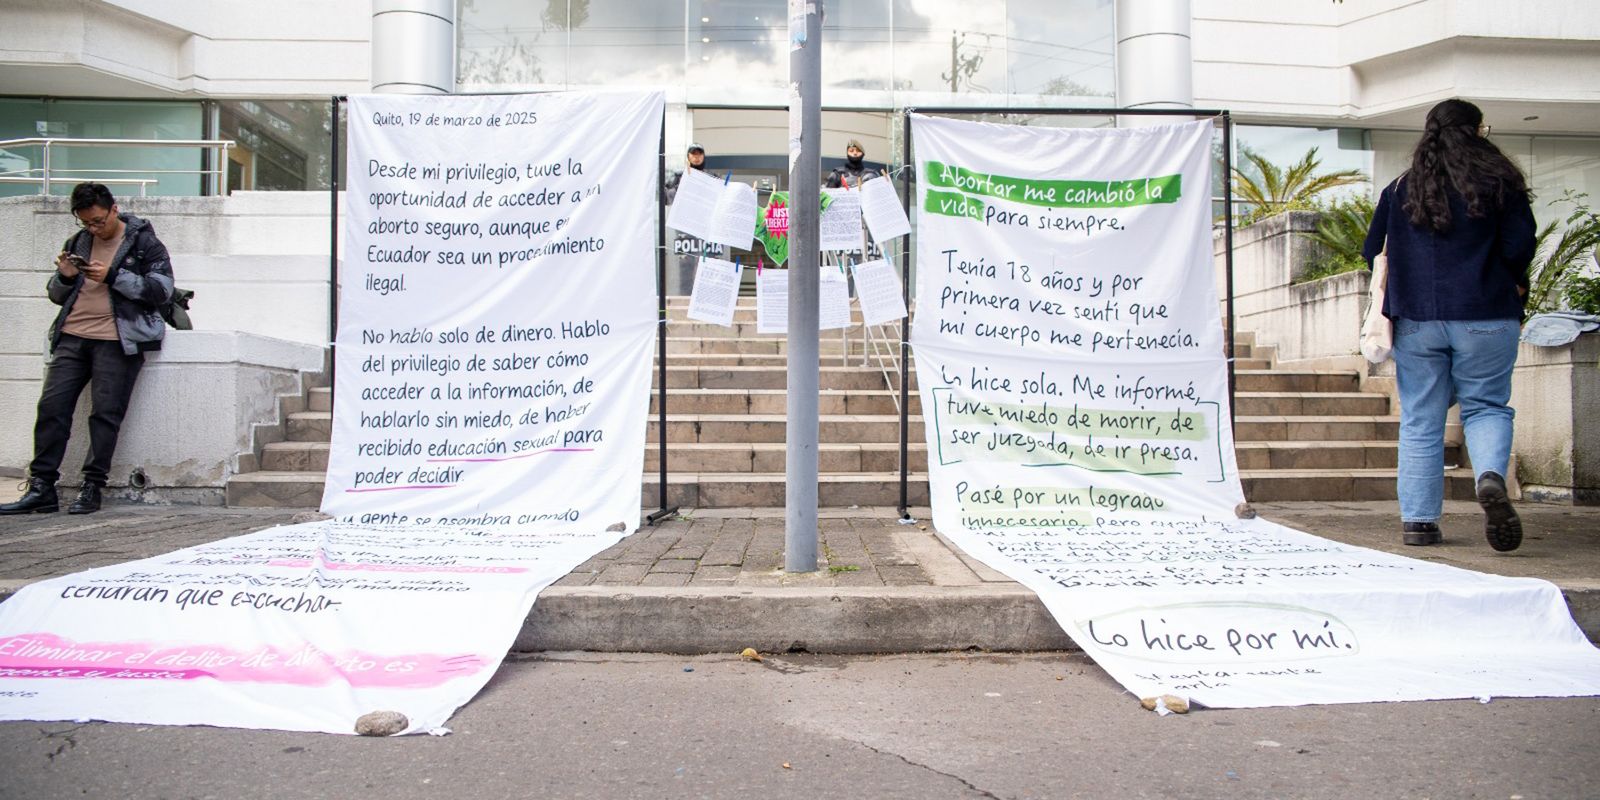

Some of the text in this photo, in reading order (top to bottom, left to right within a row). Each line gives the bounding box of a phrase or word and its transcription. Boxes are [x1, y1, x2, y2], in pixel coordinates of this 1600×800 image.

[373, 112, 537, 127] Quito, 19 de marzo de 2025
[369, 158, 583, 184] Desde mi privilegio, tuve la
[940, 165, 1162, 203] Abortar me cambió la
[369, 190, 467, 210] oportunidad
[473, 190, 492, 208] de
[499, 187, 565, 207] acceder
[571, 191, 581, 203] a
[368, 217, 418, 234] aborto
[425, 222, 482, 240] seguro,
[489, 222, 550, 239] aunque
[940, 197, 1124, 236] vida para siempre.
[368, 245, 431, 263] Ecuador
[437, 252, 465, 264] sea
[472, 252, 492, 264] un
[366, 273, 406, 296] ilegal.
[942, 250, 1143, 297] Tenía 18 años y por
[941, 280, 1168, 326] primera vez sentí que
[363, 320, 609, 344] No hablo solo de dinero. Hablo
[940, 311, 1199, 352] mi cuerpo me pertenecía.
[362, 350, 588, 376] del privilegio de saber cómo
[362, 376, 593, 400] acceder a la información, de
[971, 367, 1012, 392] hice
[1021, 372, 1062, 396] sola.
[1073, 374, 1105, 400] Me
[1115, 374, 1202, 406] informé,
[361, 403, 590, 428] hablarlo sin miedo, de haber
[948, 393, 1194, 435] tuve miedo de morir, de
[358, 430, 602, 456] recibido educación sexual para
[951, 421, 1198, 465] ser juzgada, de ir presa.
[354, 467, 403, 488] poder
[956, 481, 1164, 513] Pasé por un legrado
[962, 508, 1088, 530] innecesario.
[176, 588, 224, 610] que
[1089, 618, 1352, 655] Lo hice por mí.
[0, 638, 118, 664] Eliminar
[125, 650, 151, 664] el
[155, 651, 235, 667] delito
[241, 649, 280, 668] de
[384, 662, 416, 672] es
